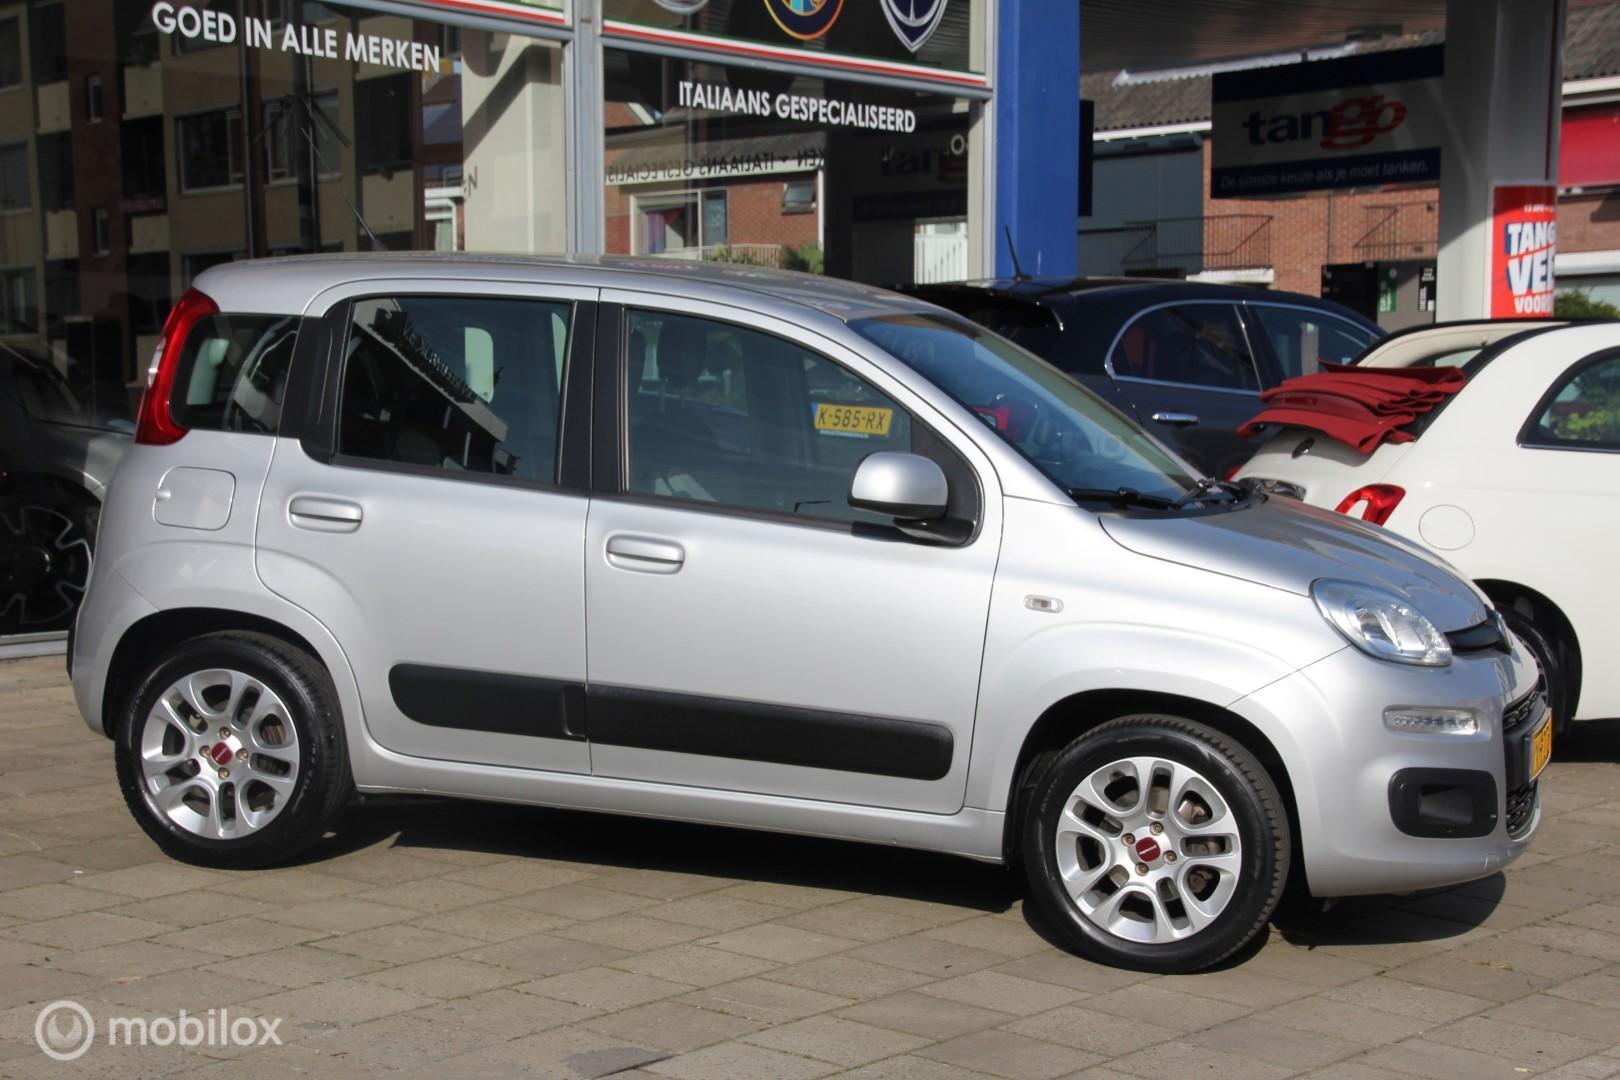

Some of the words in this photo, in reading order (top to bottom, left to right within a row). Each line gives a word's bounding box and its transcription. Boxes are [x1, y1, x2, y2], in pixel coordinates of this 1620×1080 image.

[152, 1, 237, 43] GOED
[245, 16, 273, 50] IN
[281, 22, 338, 59] ALLE
[345, 32, 440, 73] MERKEN
[678, 80, 770, 117] ITALIAANS
[775, 93, 916, 133] GESPECIALISEERD
[1242, 94, 1407, 152] tango
[1280, 168, 1313, 185] keuze
[1316, 165, 1333, 181] als
[1333, 166, 1347, 184] je
[1349, 161, 1380, 178] moet
[1382, 159, 1429, 177] tanken.
[817, 406, 887, 432] K-585-RX
